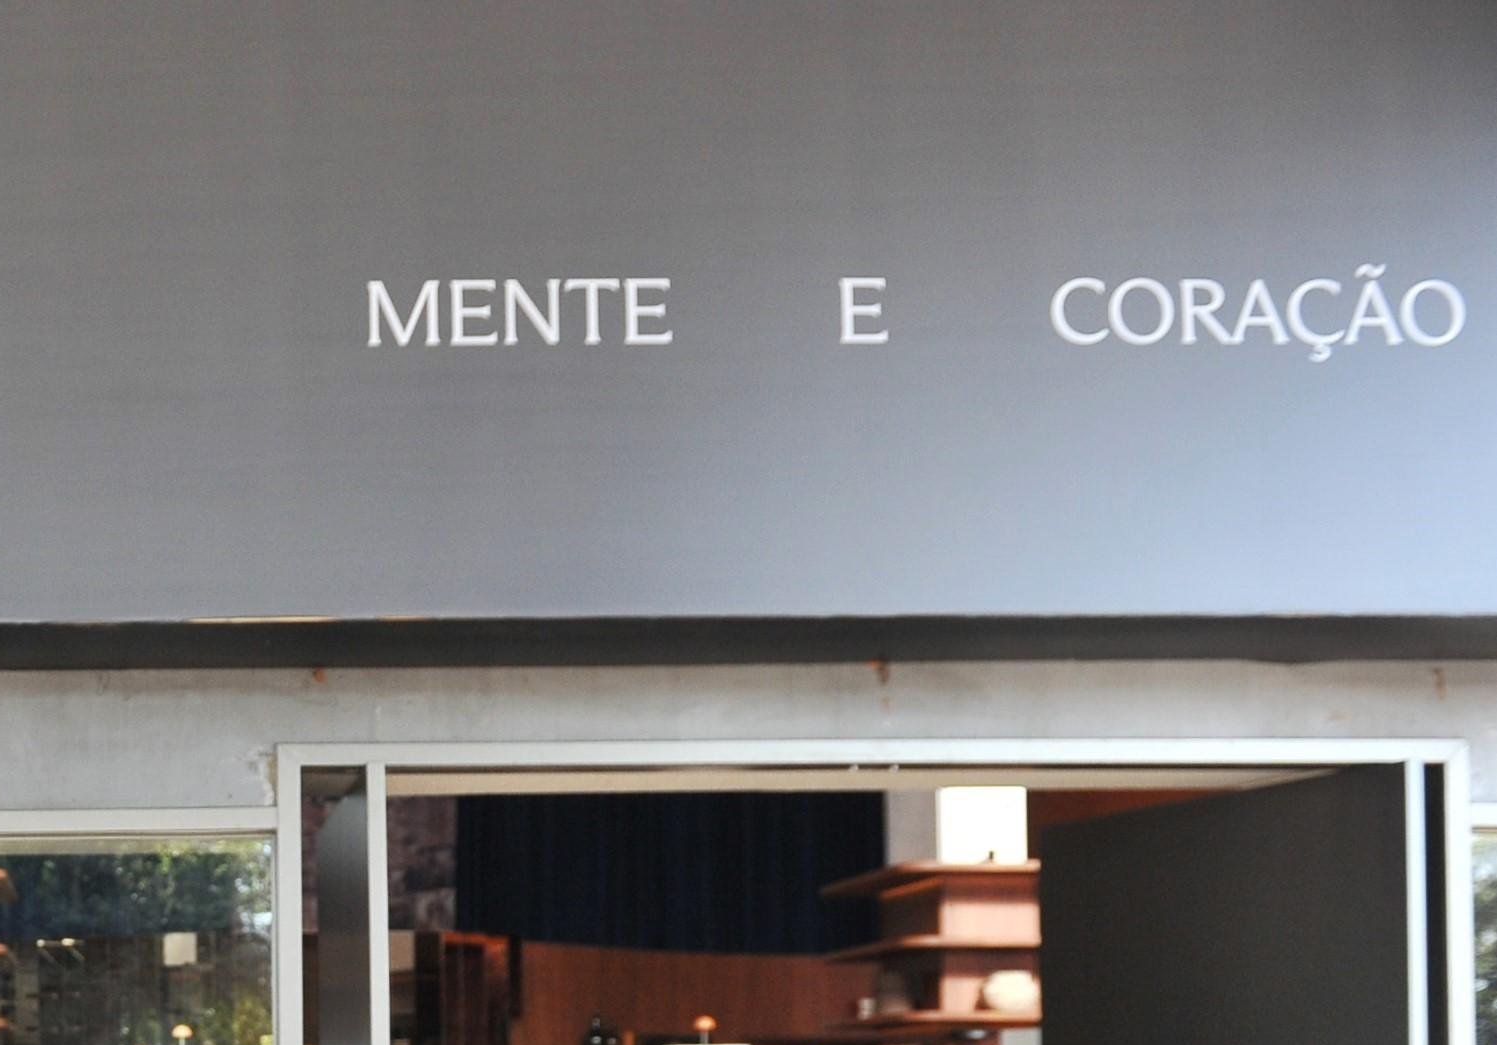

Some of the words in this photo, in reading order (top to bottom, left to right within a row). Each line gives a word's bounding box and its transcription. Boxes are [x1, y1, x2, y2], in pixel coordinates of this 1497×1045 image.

[366, 277, 675, 348] MENTE
[839, 277, 889, 346] E
[1050, 262, 1467, 364] CORAÇÃO
